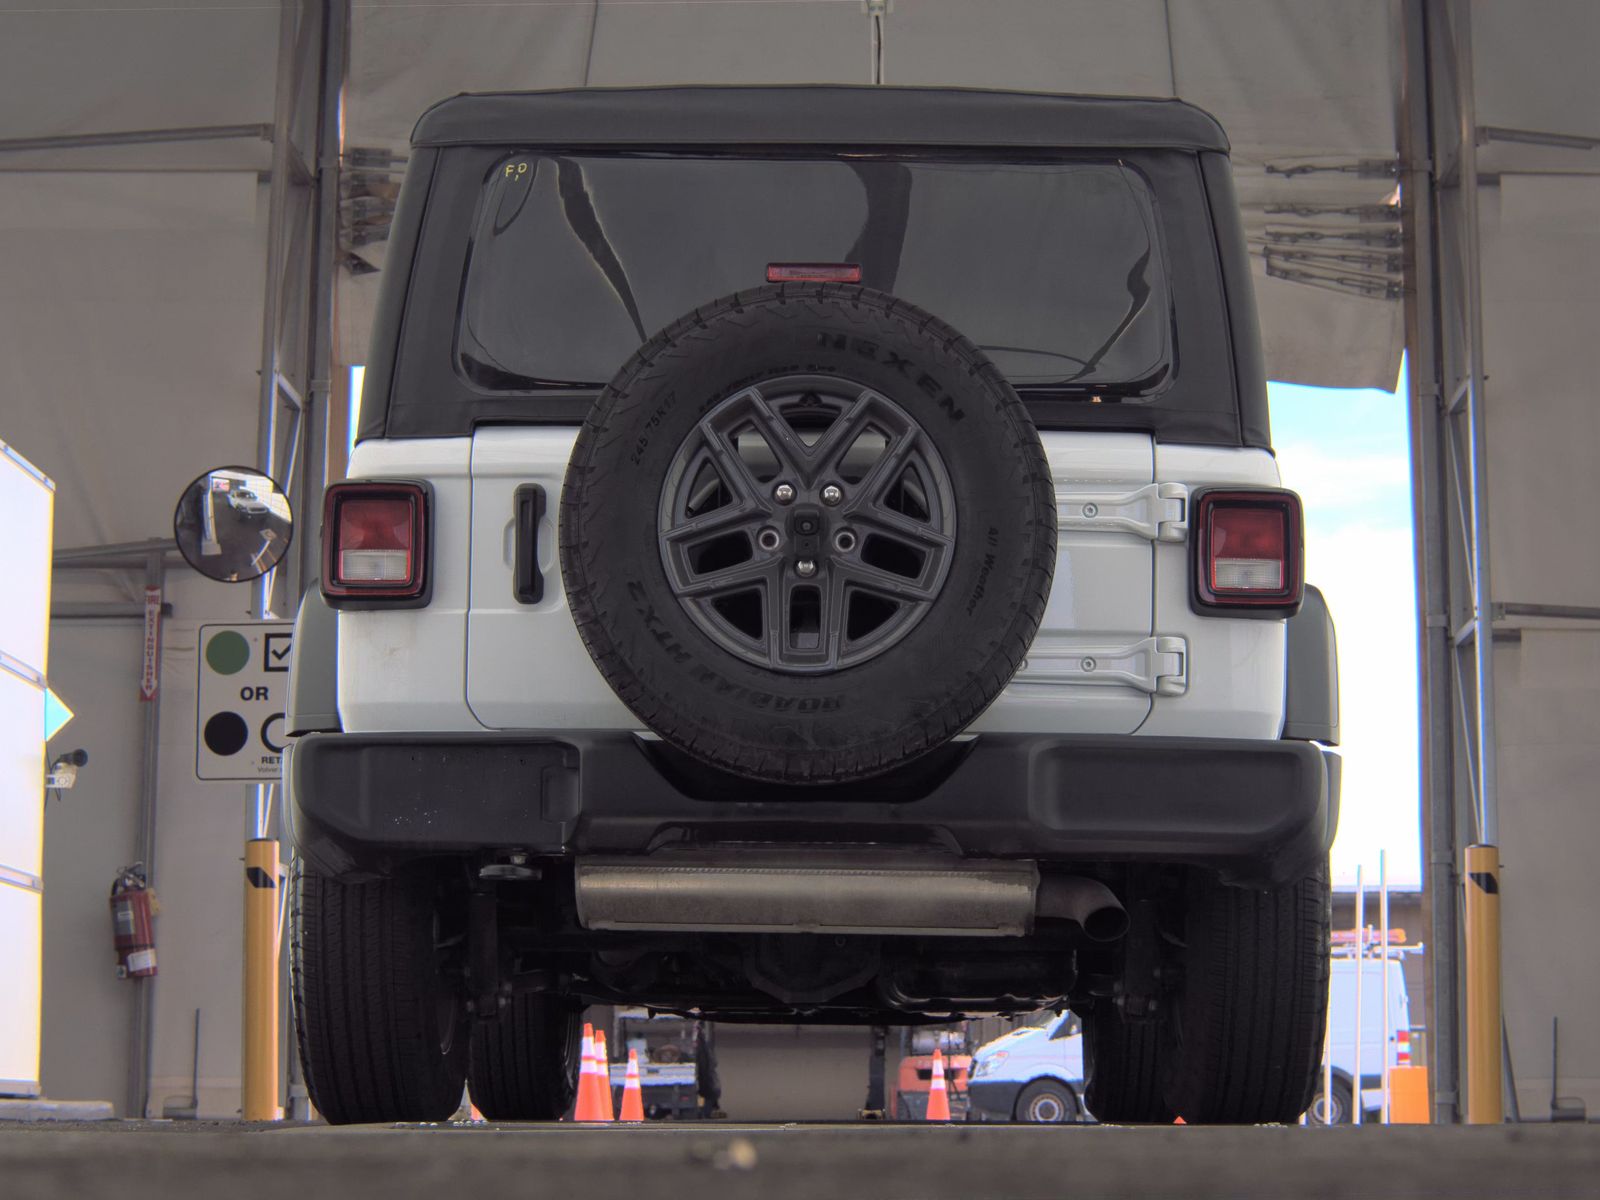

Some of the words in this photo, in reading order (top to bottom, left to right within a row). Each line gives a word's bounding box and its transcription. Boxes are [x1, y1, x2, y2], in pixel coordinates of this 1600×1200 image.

[816, 332, 967, 423] NEXEN
[240, 686, 269, 701] OR
[261, 756, 281, 765] RET
